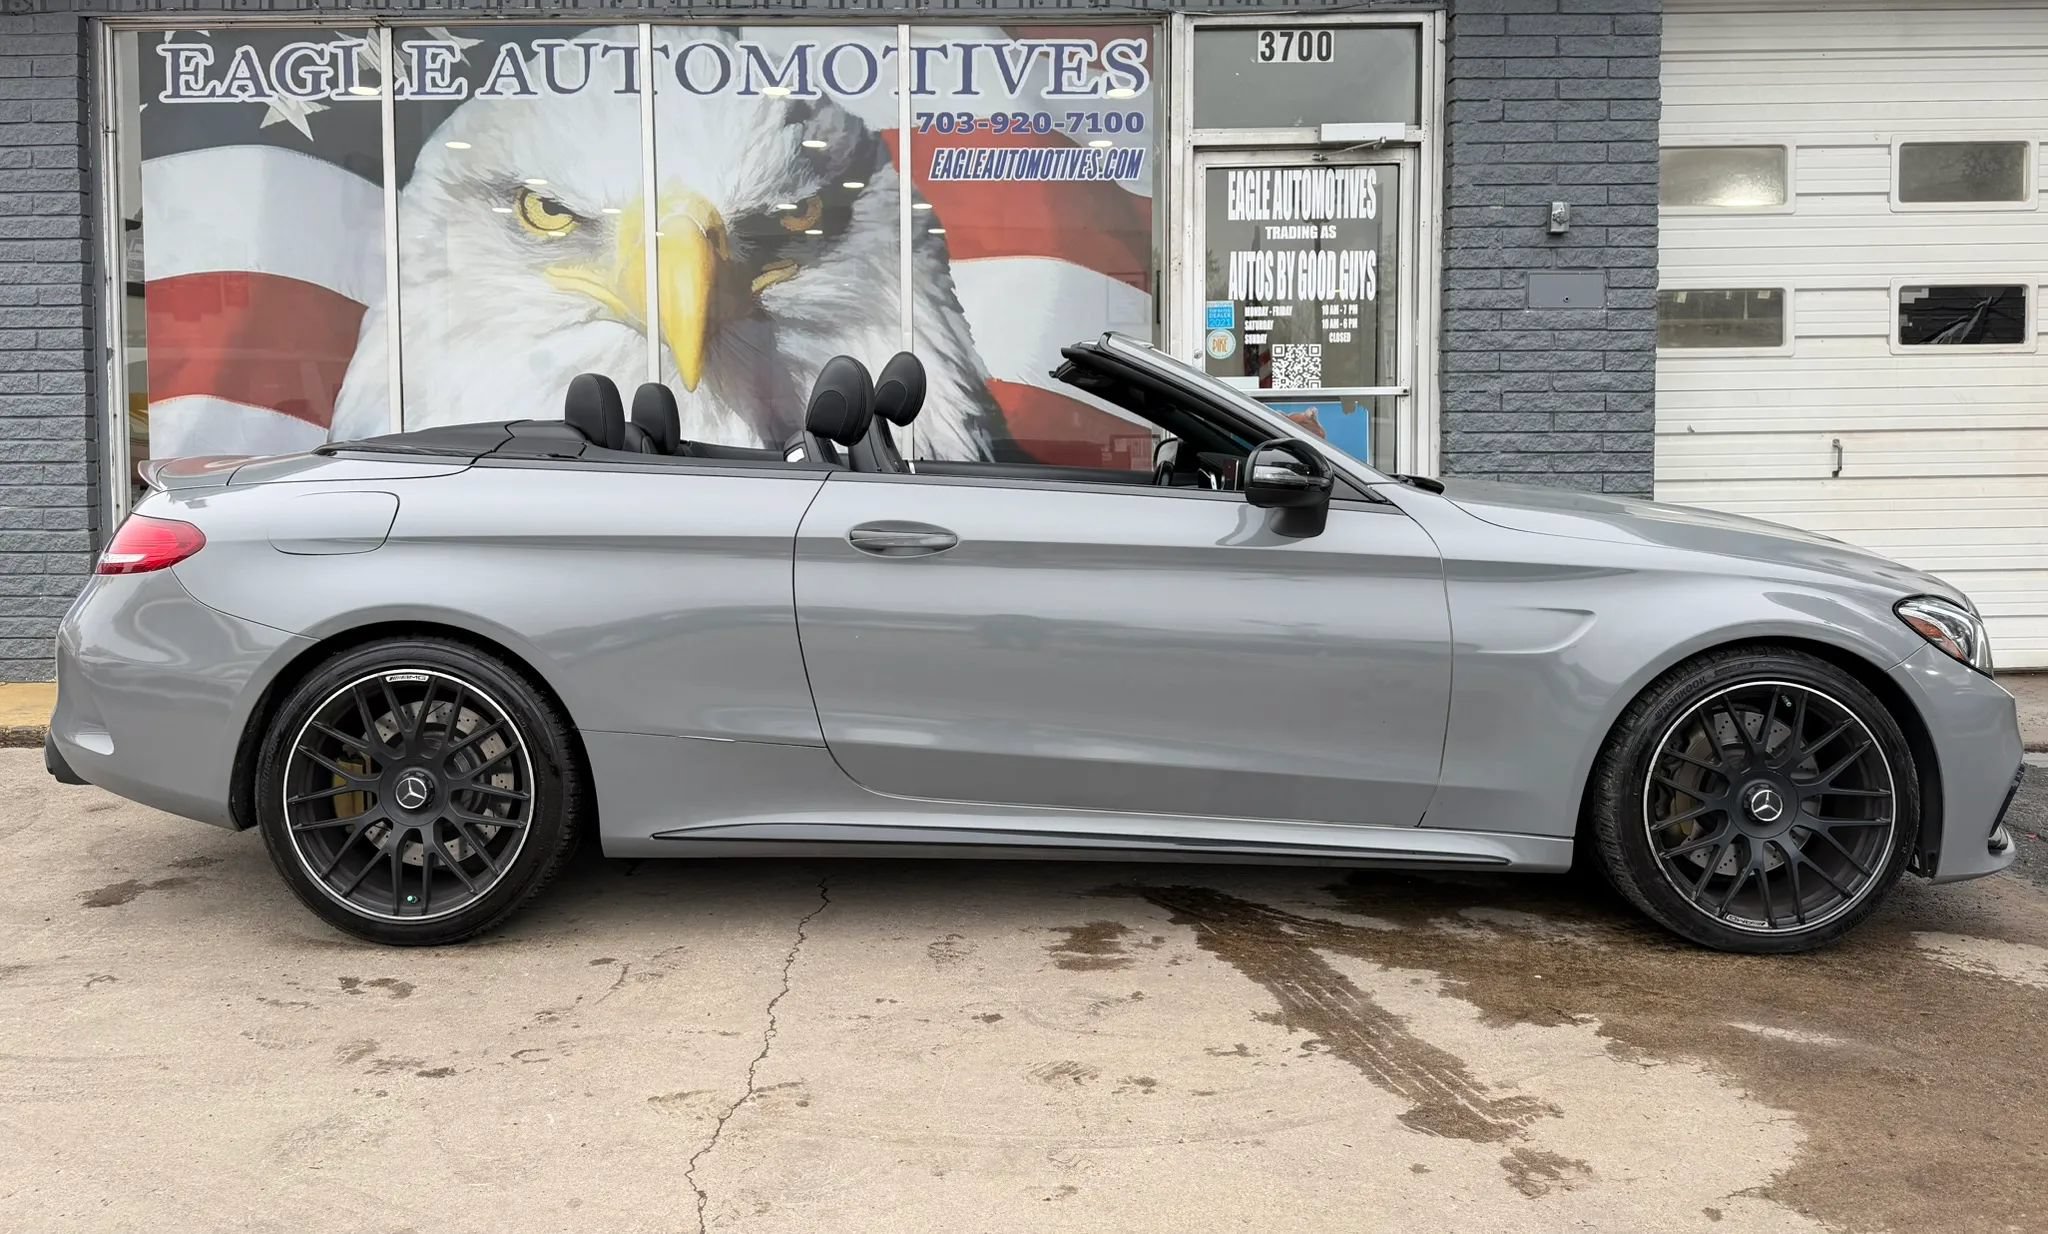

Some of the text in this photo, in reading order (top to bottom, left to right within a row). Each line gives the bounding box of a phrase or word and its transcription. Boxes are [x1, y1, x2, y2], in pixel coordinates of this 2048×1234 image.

[1259, 31, 1333, 62] 3700
[158, 40, 1148, 100] EAGLE AUTOMOTIVES
[916, 112, 1145, 134] 703-920-7100
[930, 148, 1144, 180] EAGLEAUTOMOTIVES.COM
[1228, 168, 1377, 221] EAGLE AUTOMOTIVES
[1265, 225, 1336, 239] TRADING AS
[1228, 250, 1377, 301] AUTOS BY GOOD GUYS
[1329, 304, 1339, 315] AM
[1343, 304, 1347, 315] 7
[1329, 318, 1339, 329] AM
[1328, 332, 1351, 343] CLOSED
